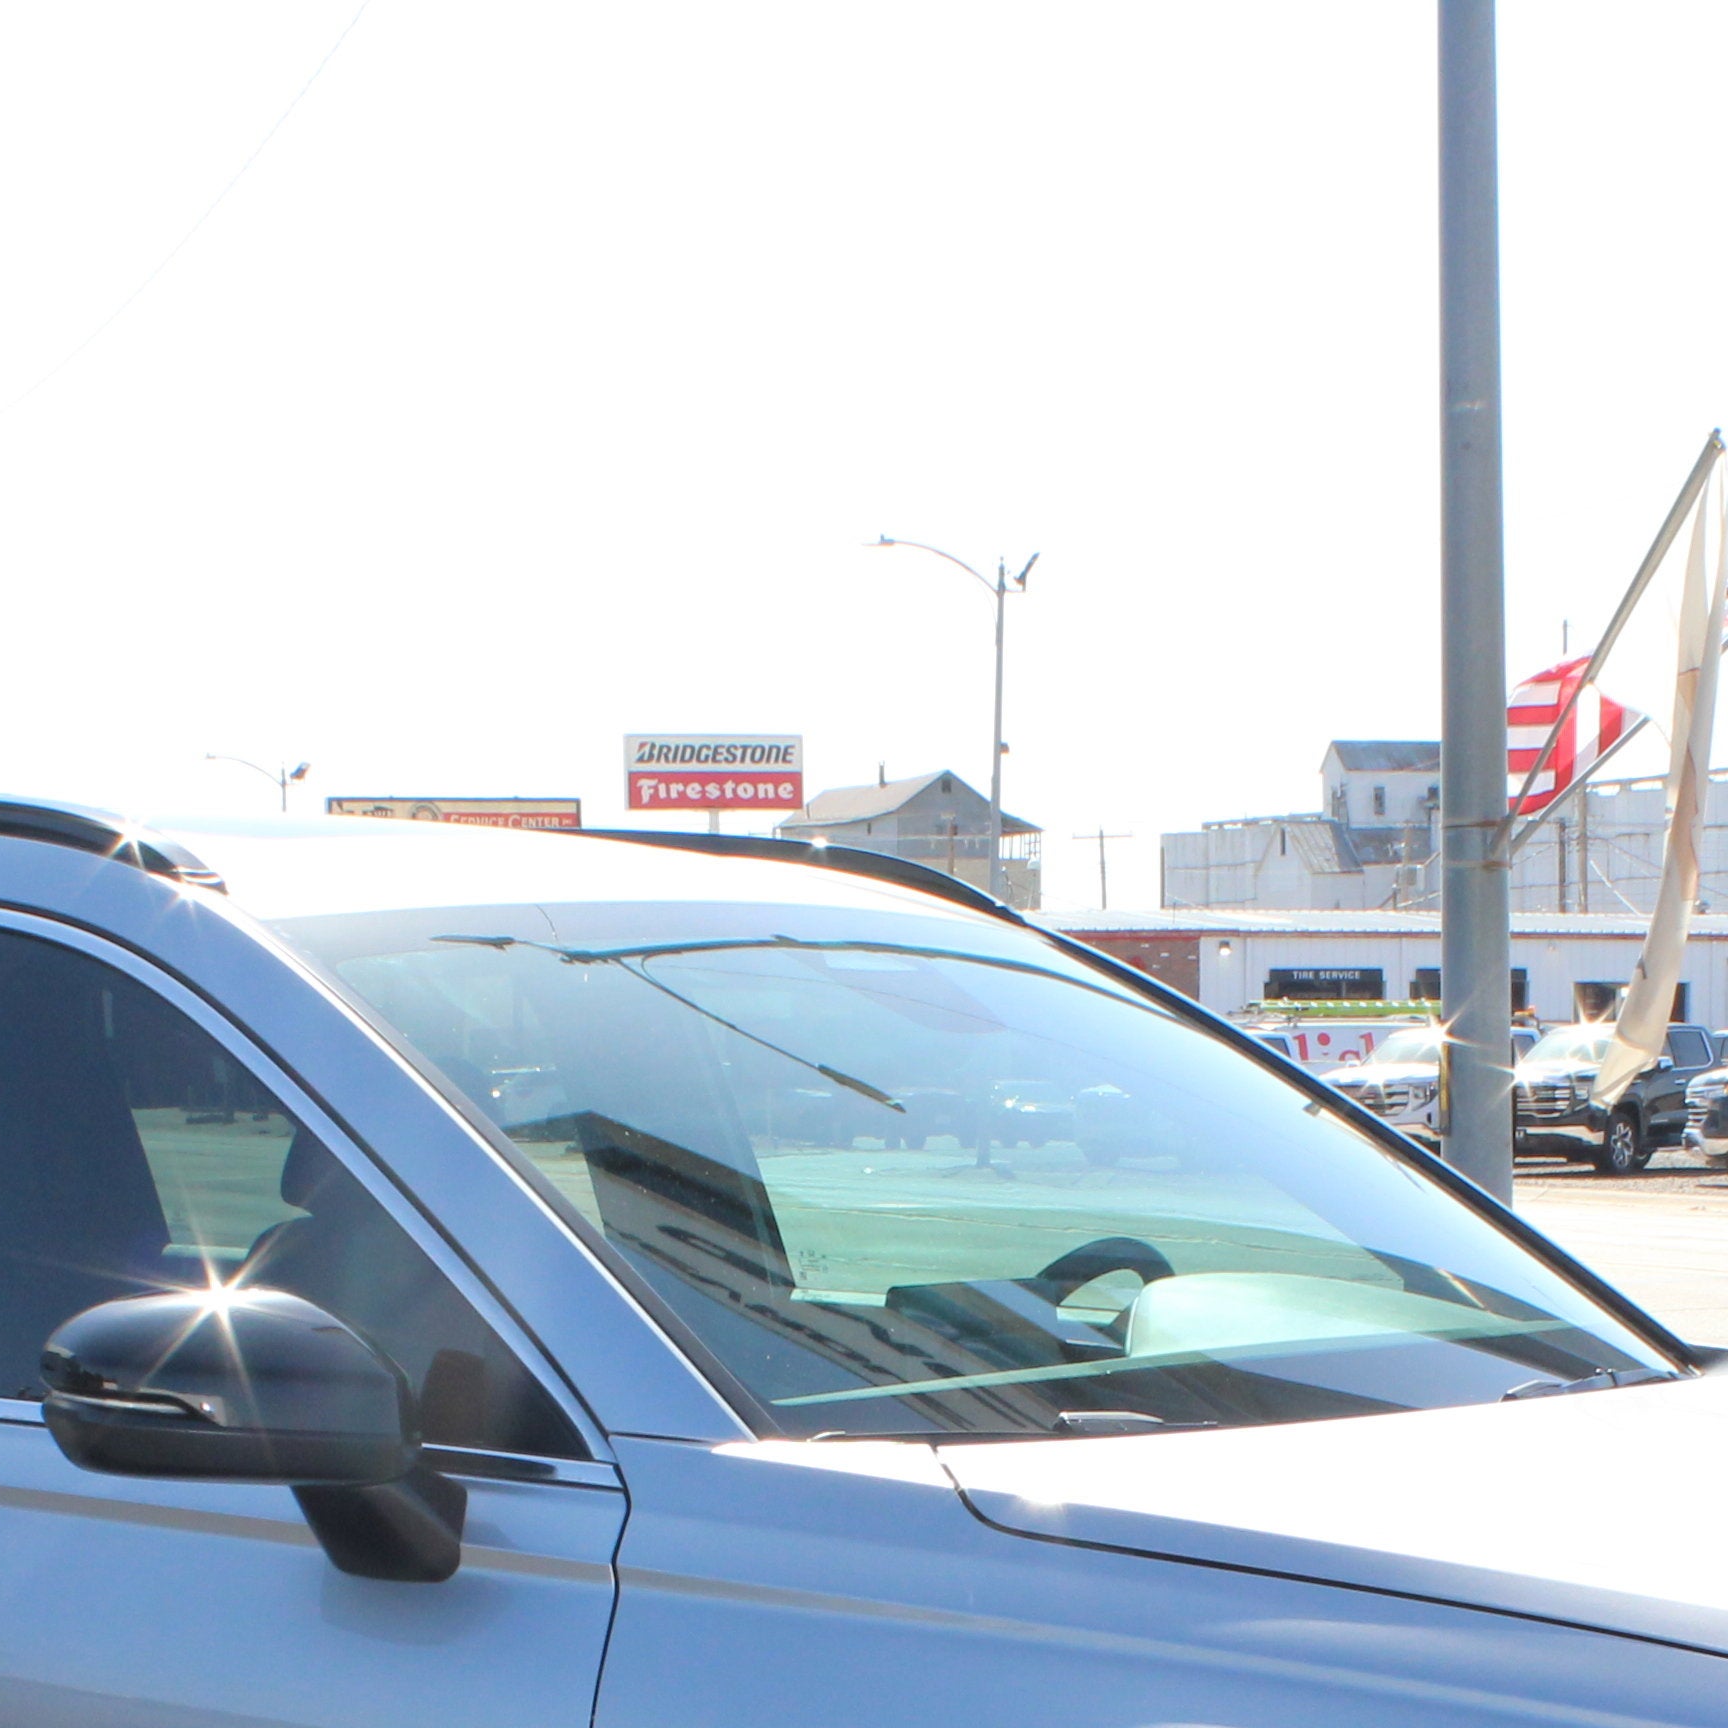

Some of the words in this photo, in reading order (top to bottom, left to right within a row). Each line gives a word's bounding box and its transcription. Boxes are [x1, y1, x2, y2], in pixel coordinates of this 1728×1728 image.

[635, 741, 796, 764] BRIDGESTONE
[636, 778, 795, 805] Firestone
[508, 814, 560, 828] CENTER
[1292, 970, 1315, 980] TIRE
[1319, 970, 1361, 980] SERVICE
